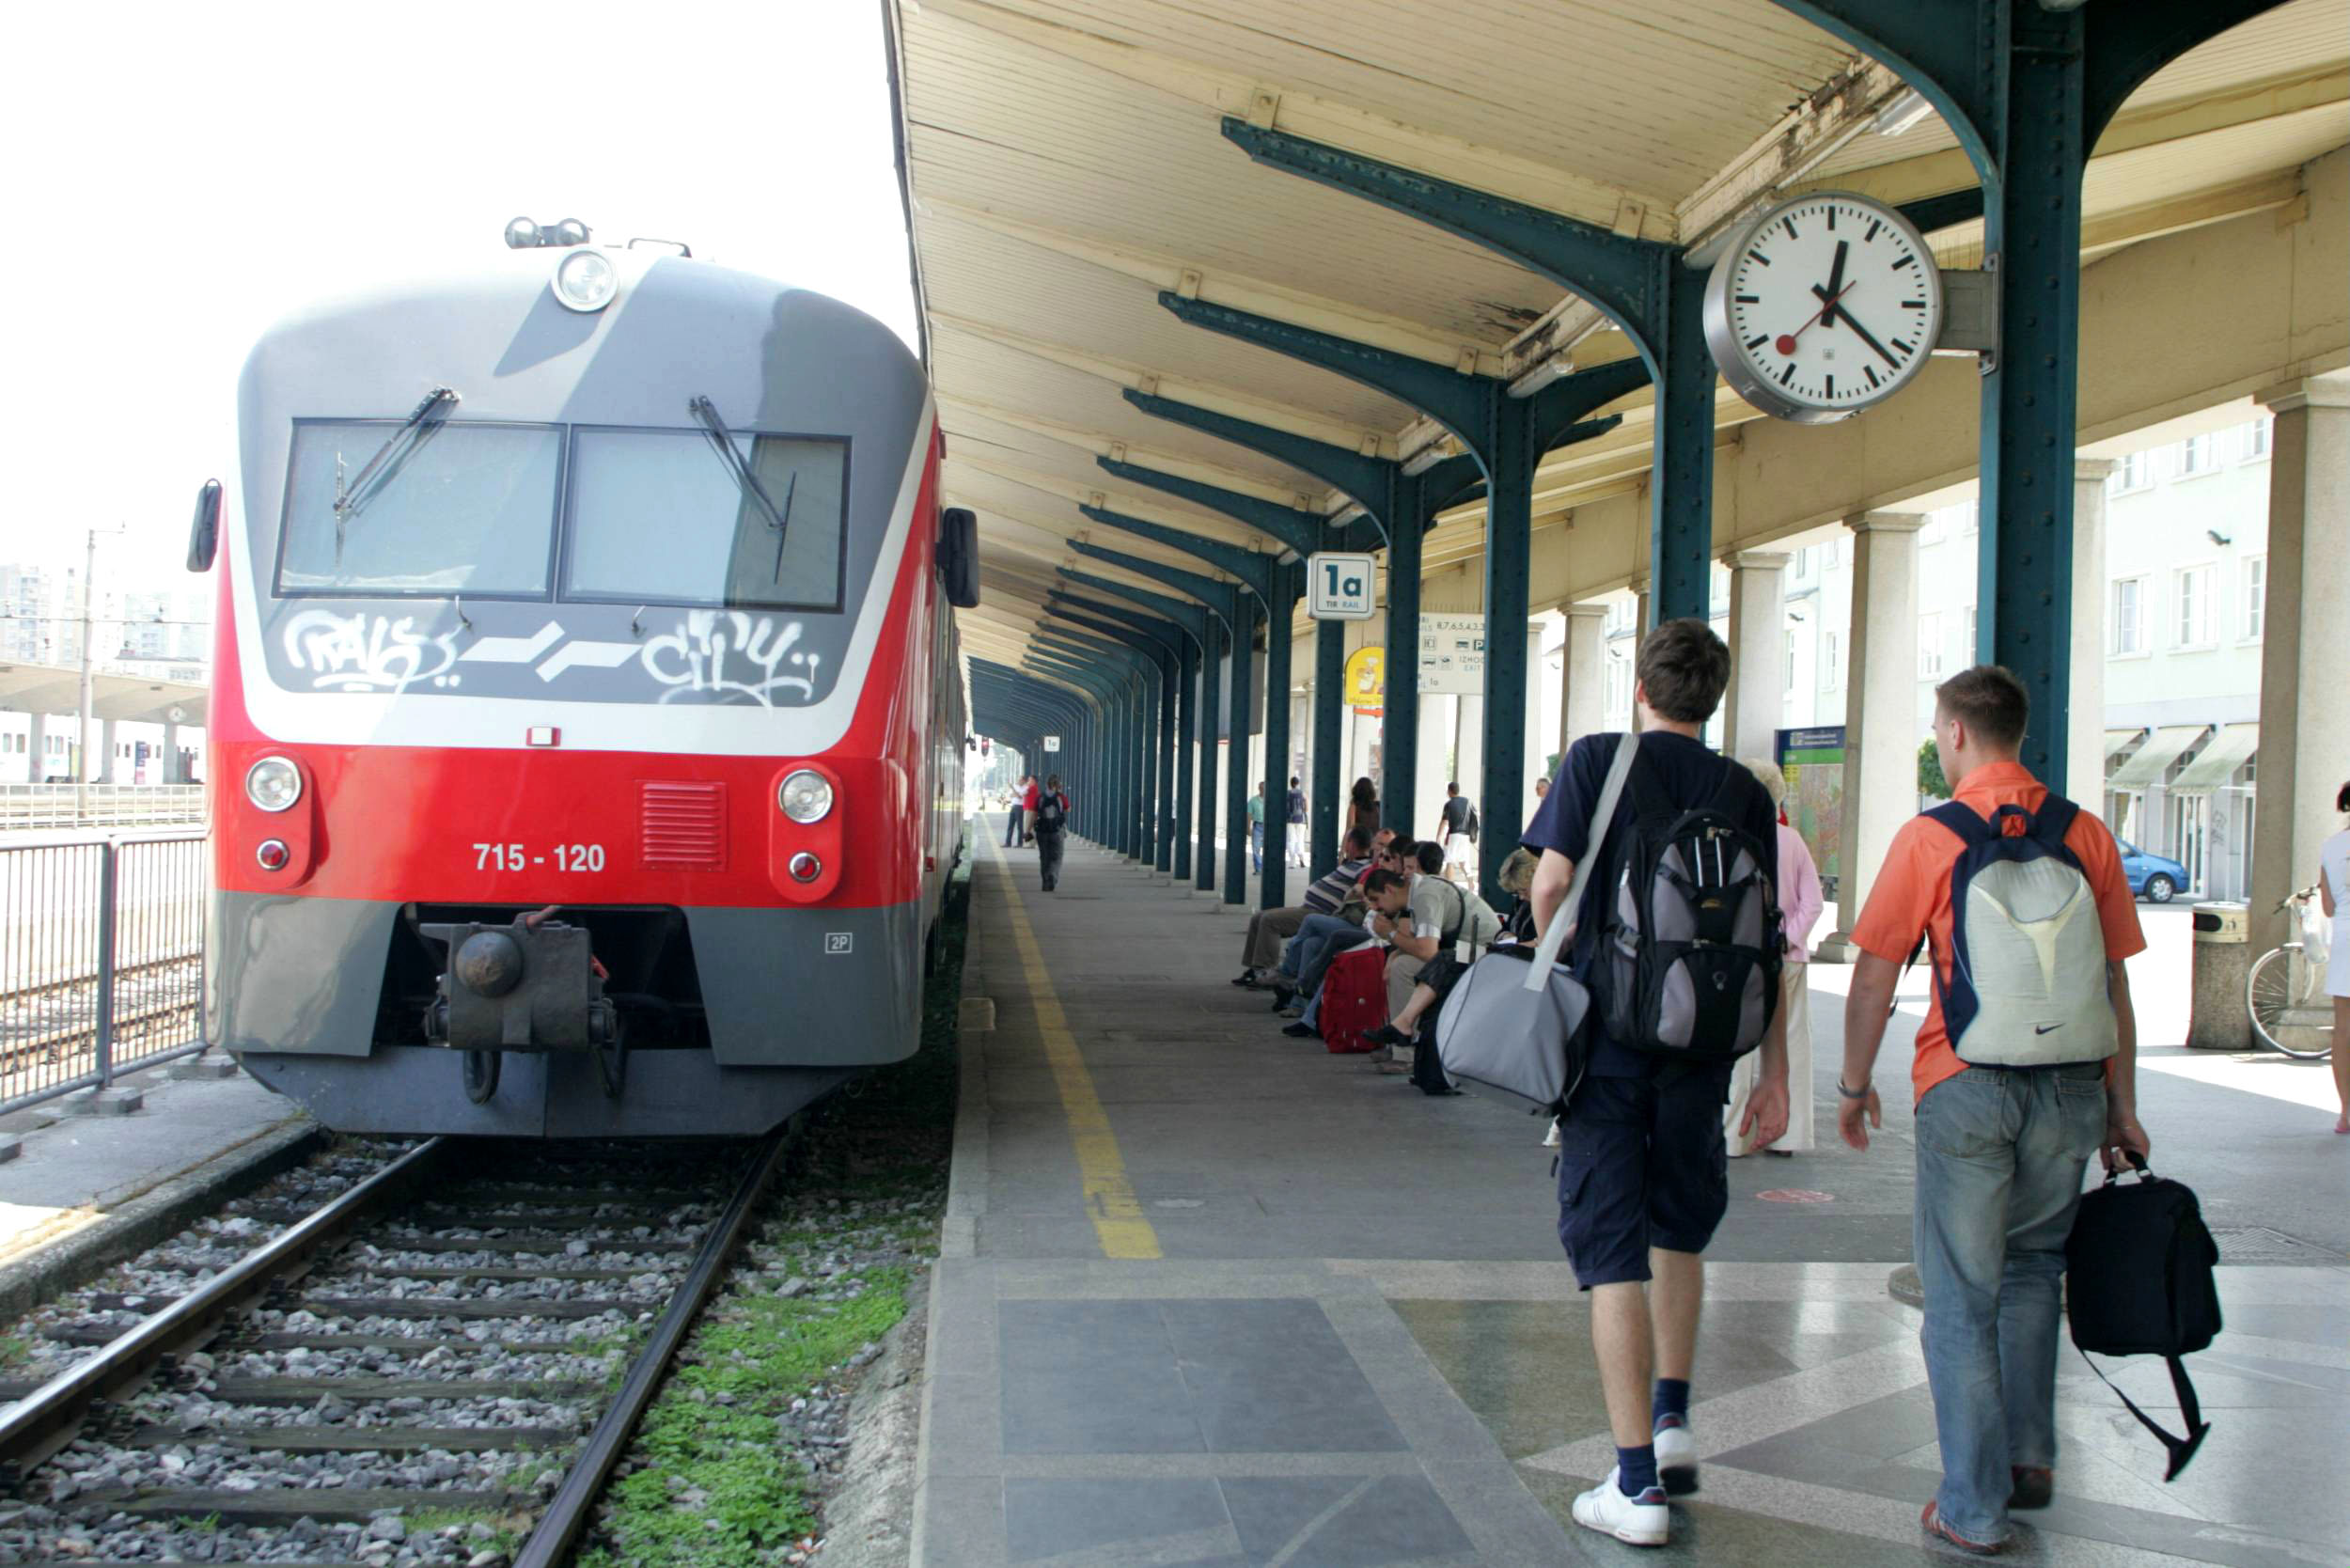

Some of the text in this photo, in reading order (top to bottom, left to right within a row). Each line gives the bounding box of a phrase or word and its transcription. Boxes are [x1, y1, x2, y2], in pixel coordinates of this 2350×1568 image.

[1325, 564, 1361, 597] 1a
[473, 843, 525, 871] 715
[554, 844, 605, 871] 120
[831, 935, 848, 949] 2P
